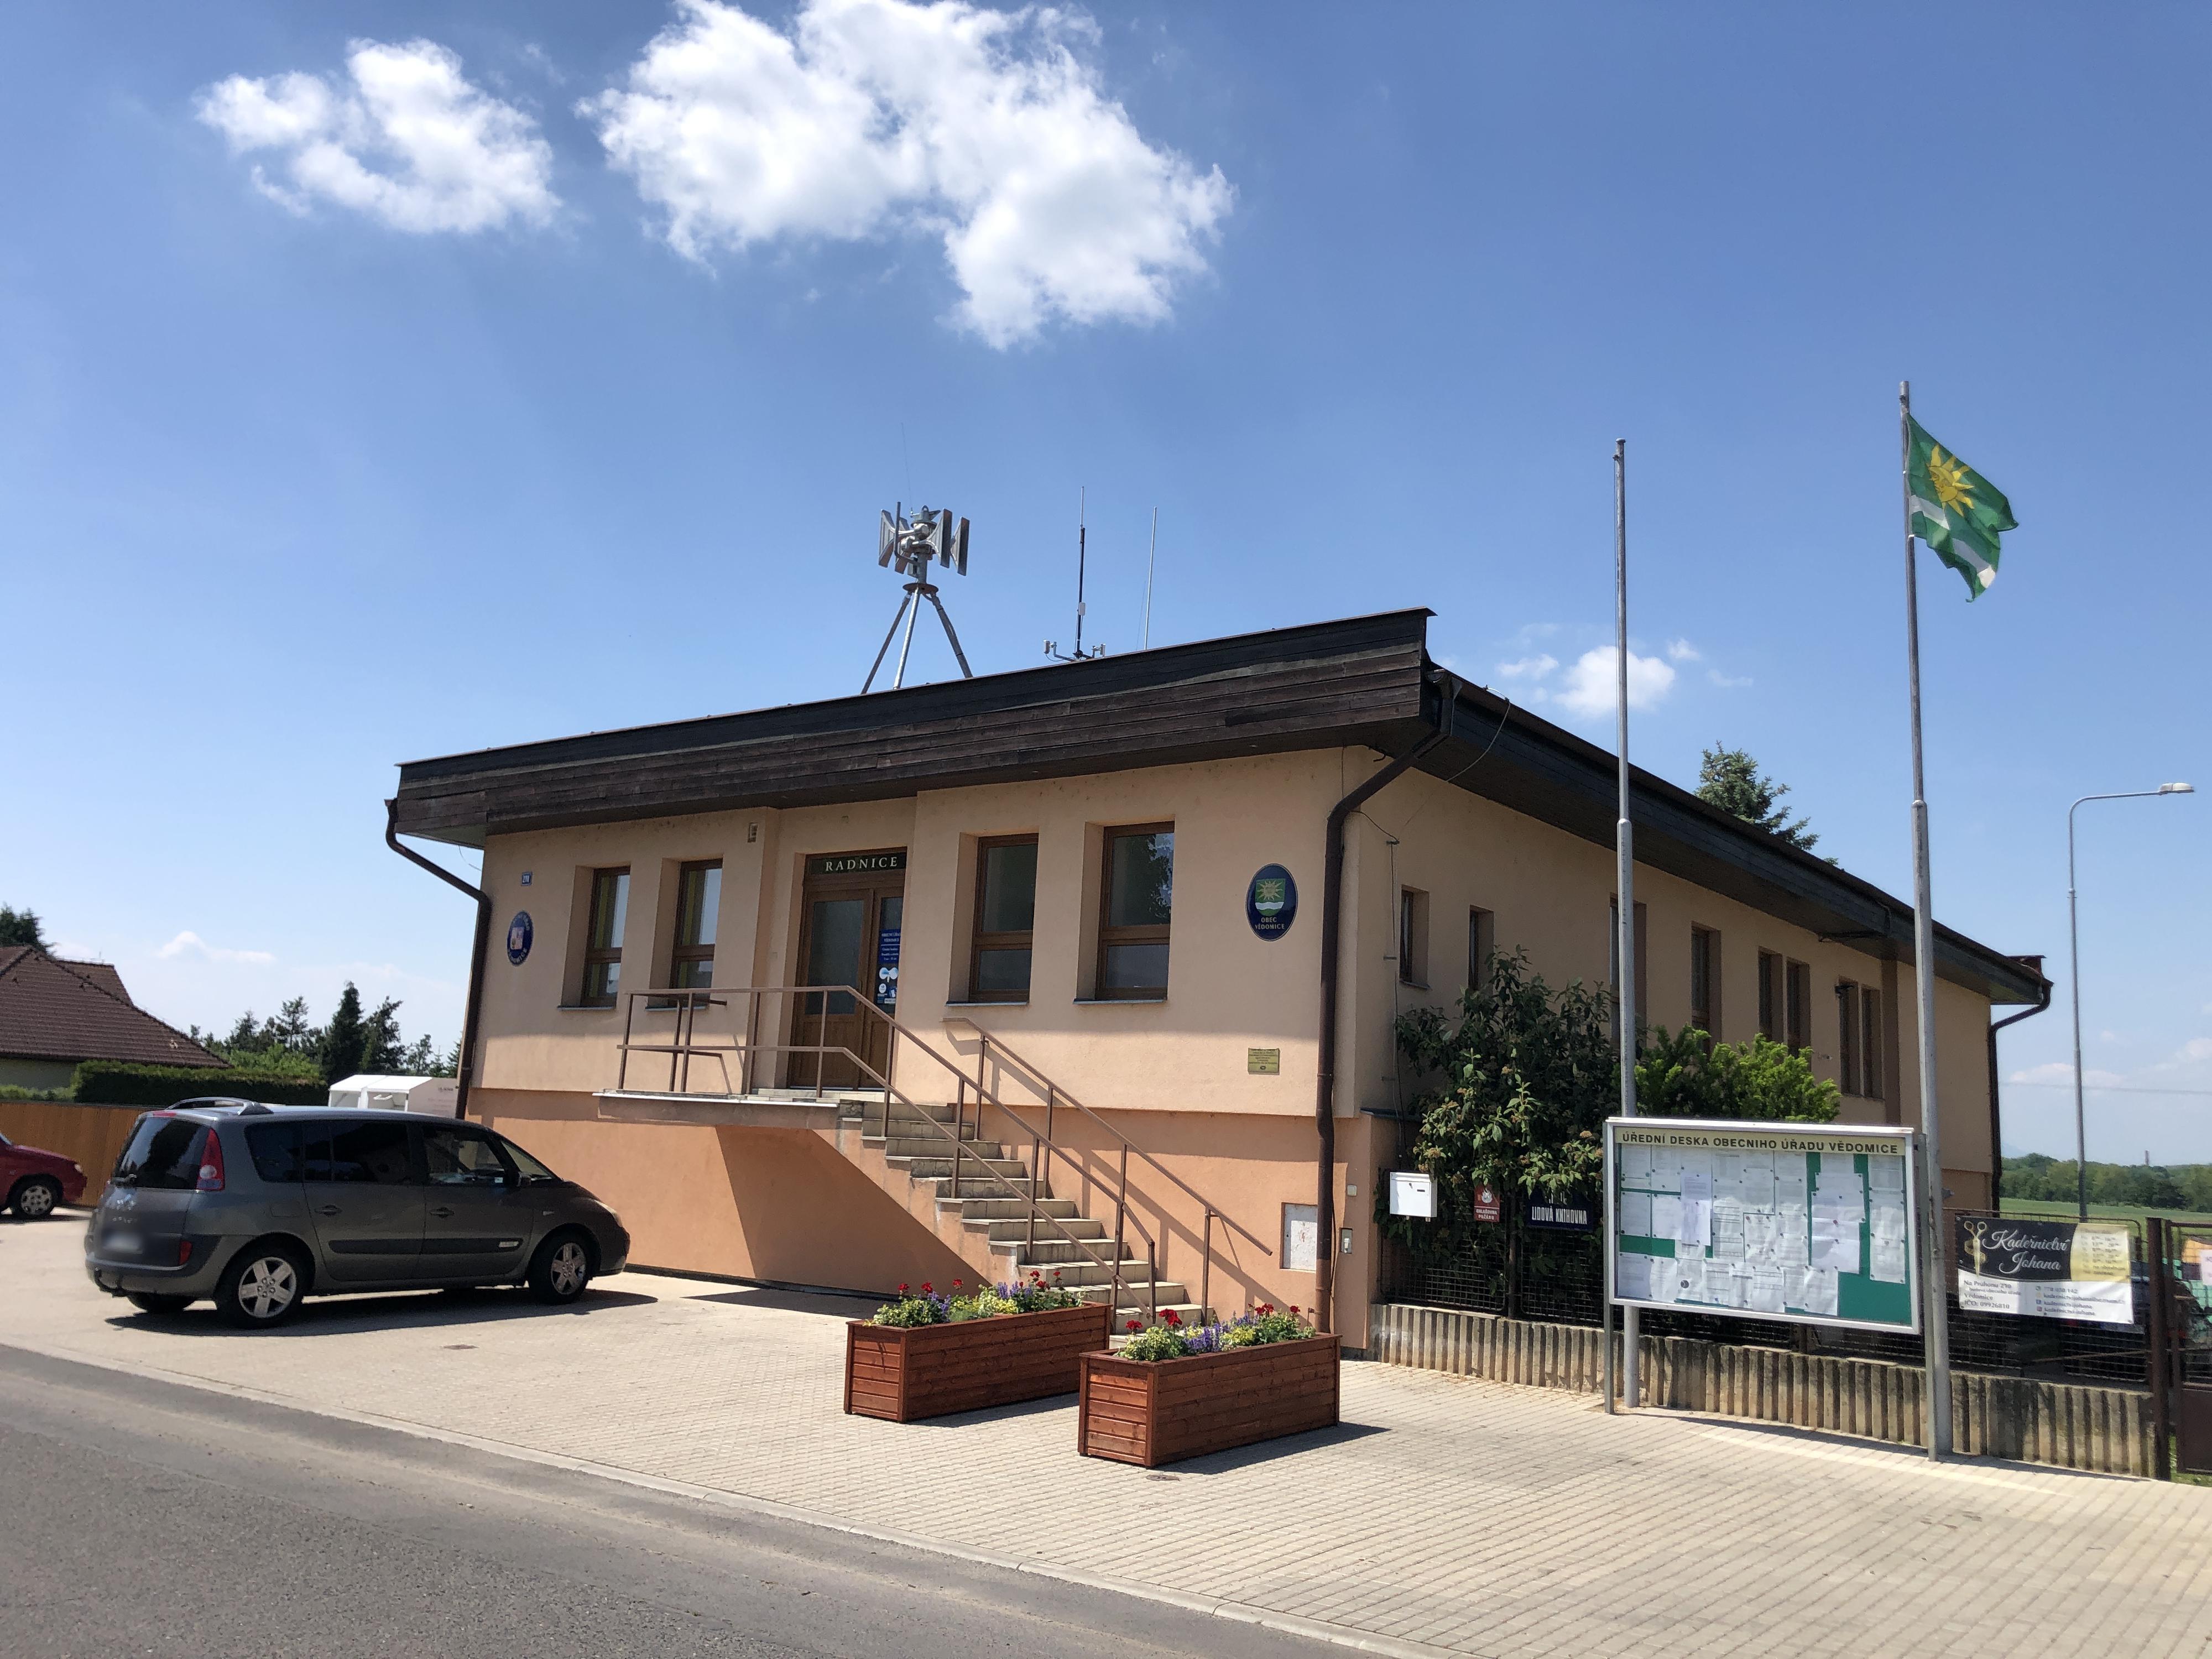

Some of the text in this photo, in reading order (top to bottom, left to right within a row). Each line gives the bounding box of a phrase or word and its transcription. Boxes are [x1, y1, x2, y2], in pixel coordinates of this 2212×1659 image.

[825, 857, 898, 872] RADNICE
[1623, 1131, 1665, 1144] ÚŘEDNÍ
[1670, 1136, 1709, 1146] DESKA
[1781, 1138, 1824, 1151] ÚŘADU
[1828, 1140, 1898, 1154] VĚDOMICE
[1532, 1206, 1588, 1225] LIDOVÁ KNIHOVNA
[1982, 1229, 2071, 1251] Kadeřnictví
[1999, 1250, 2062, 1274] Johana
